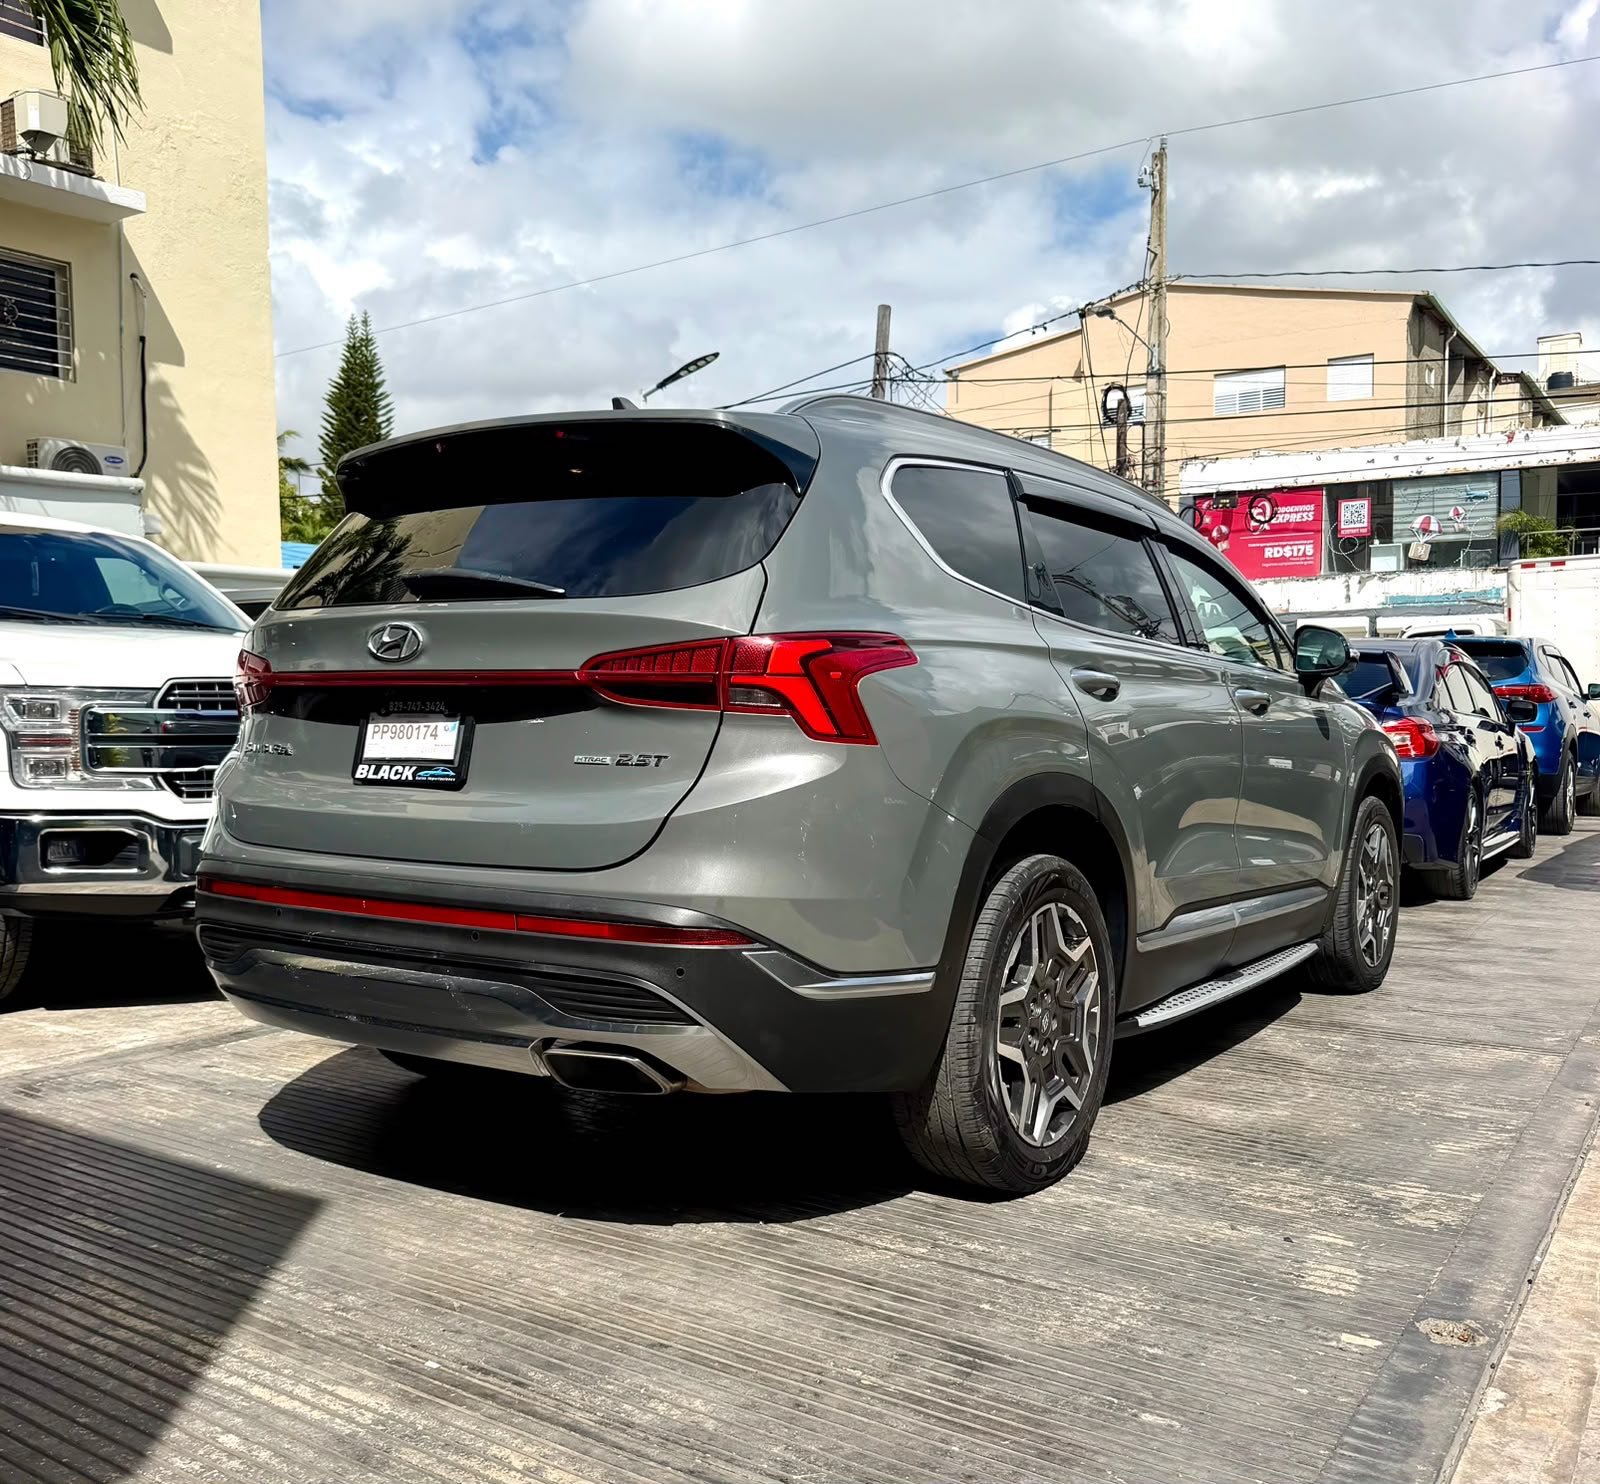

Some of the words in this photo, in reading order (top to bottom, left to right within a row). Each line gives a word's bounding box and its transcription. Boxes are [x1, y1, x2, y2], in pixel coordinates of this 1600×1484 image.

[1270, 512, 1314, 523] EXPRESS
[1264, 545, 1314, 558] RD$175
[371, 724, 438, 740] PP980174
[616, 754, 669, 767] 2.5T
[354, 764, 418, 780] BLACK
